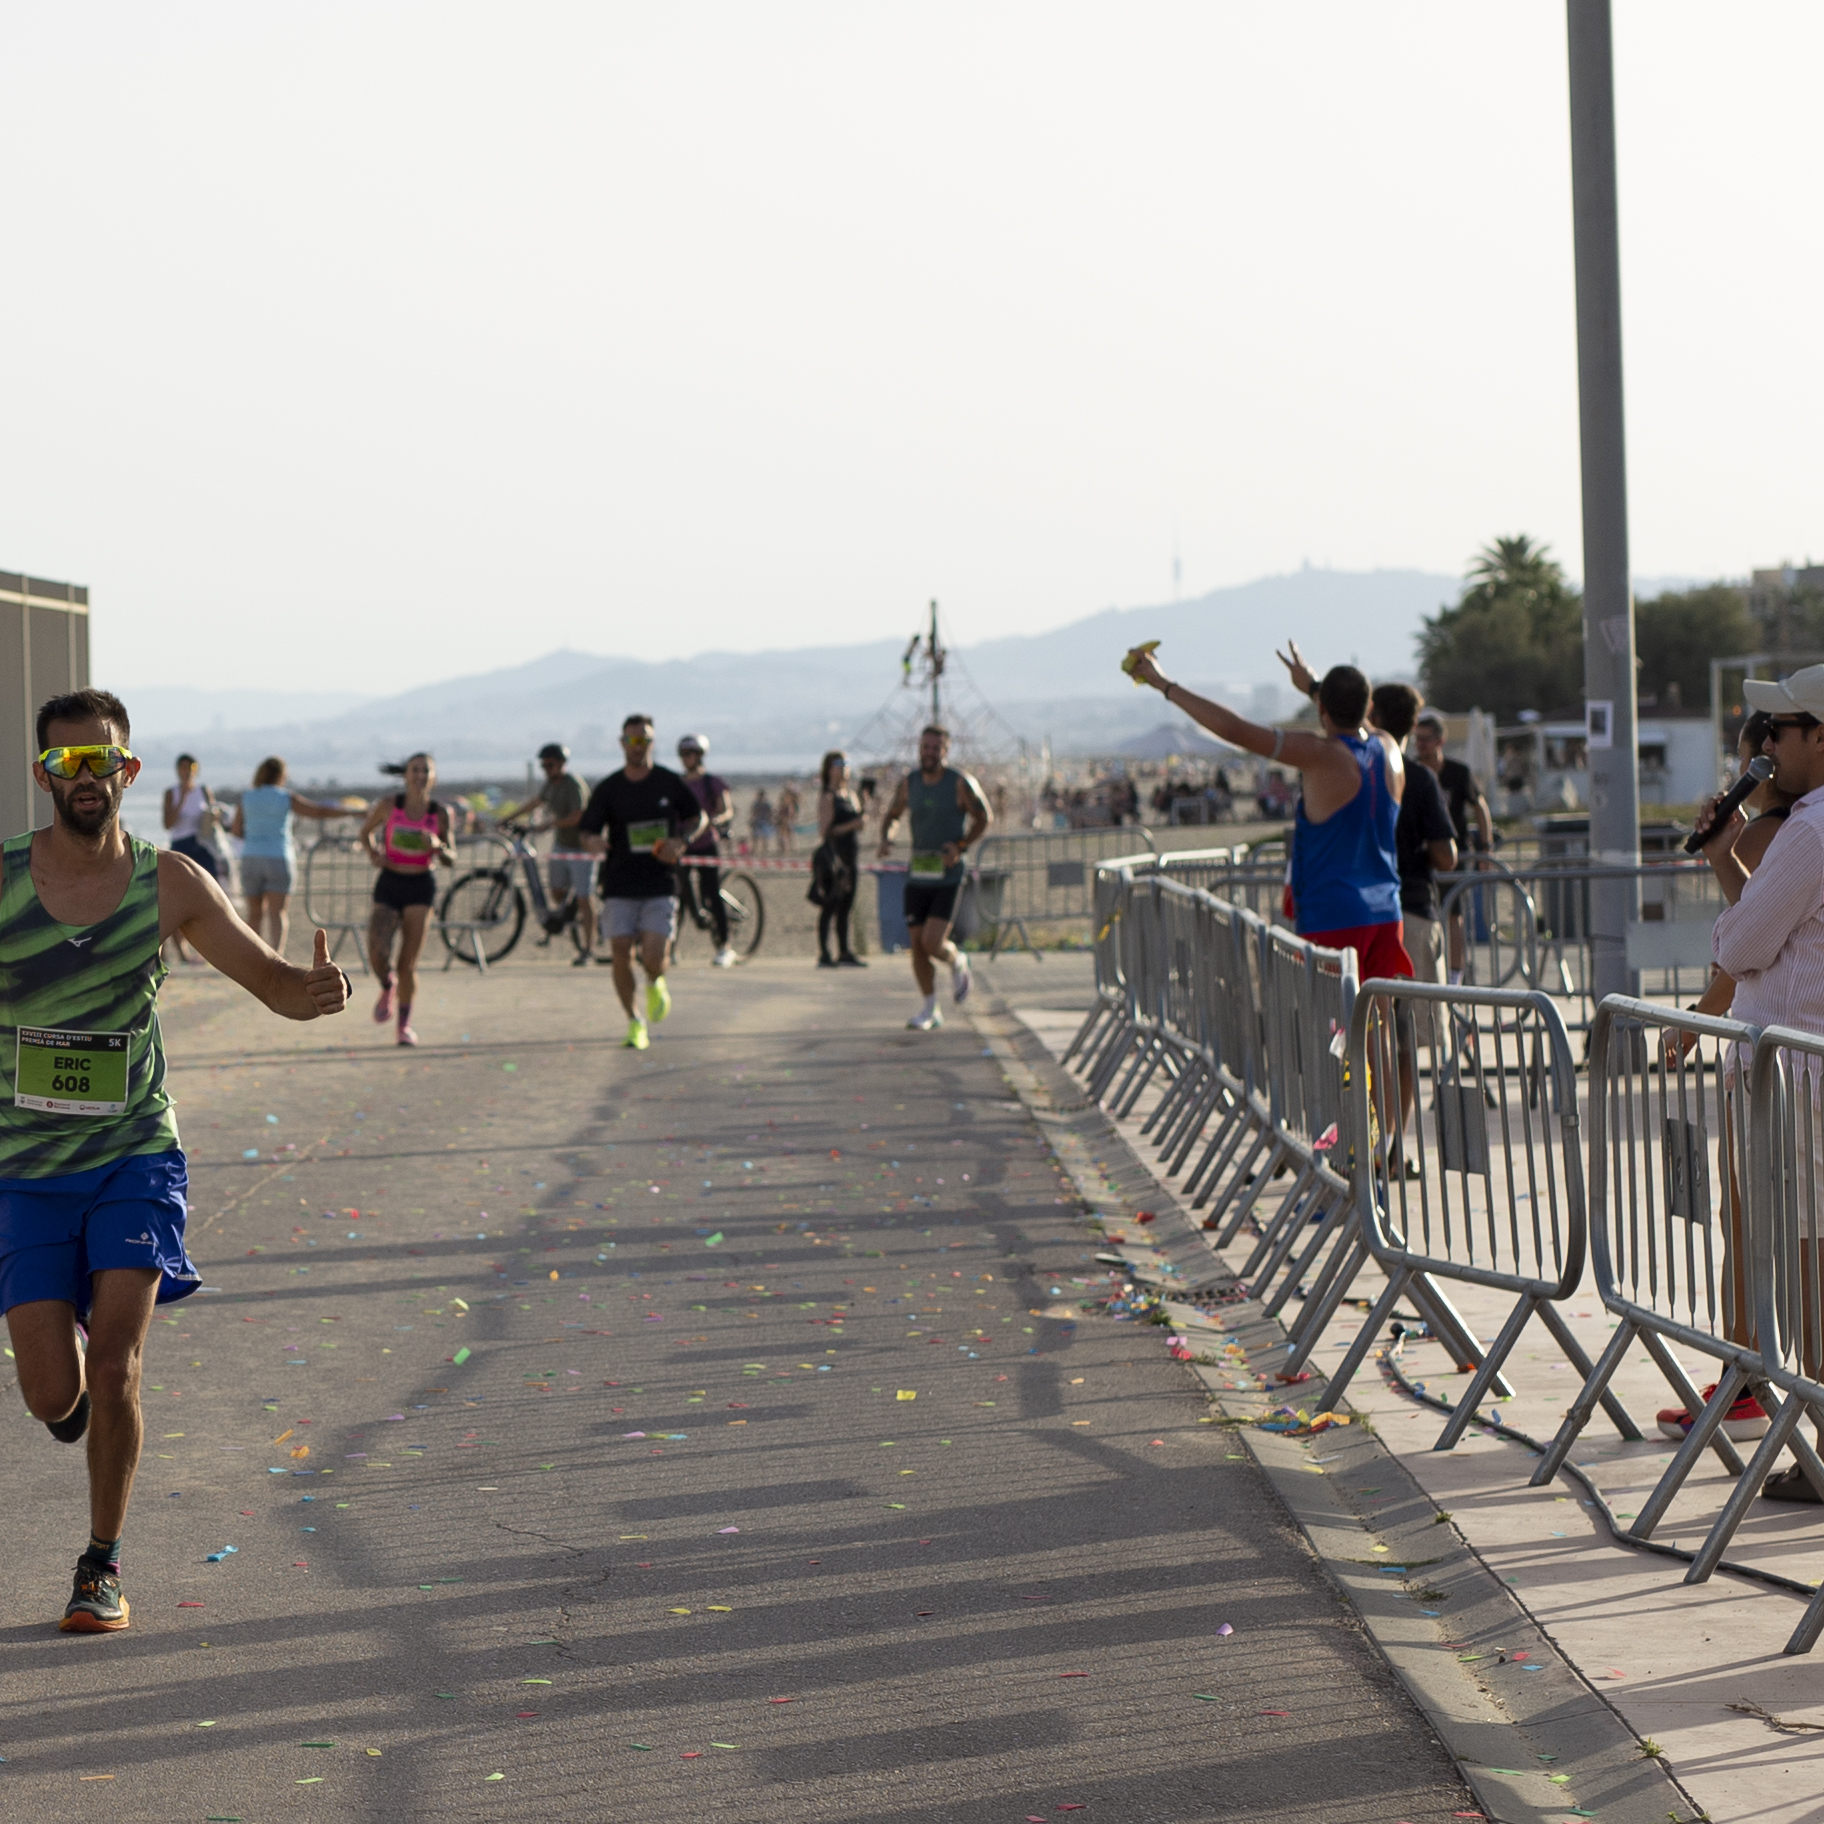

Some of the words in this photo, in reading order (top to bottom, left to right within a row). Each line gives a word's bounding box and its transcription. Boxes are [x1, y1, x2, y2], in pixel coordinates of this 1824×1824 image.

[43, 1032, 65, 1040] CURSA
[66, 1034, 93, 1042] D'ESTIU
[108, 1038, 122, 1047] 5K
[53, 1056, 92, 1072] ERIC
[51, 1074, 91, 1093] 608
